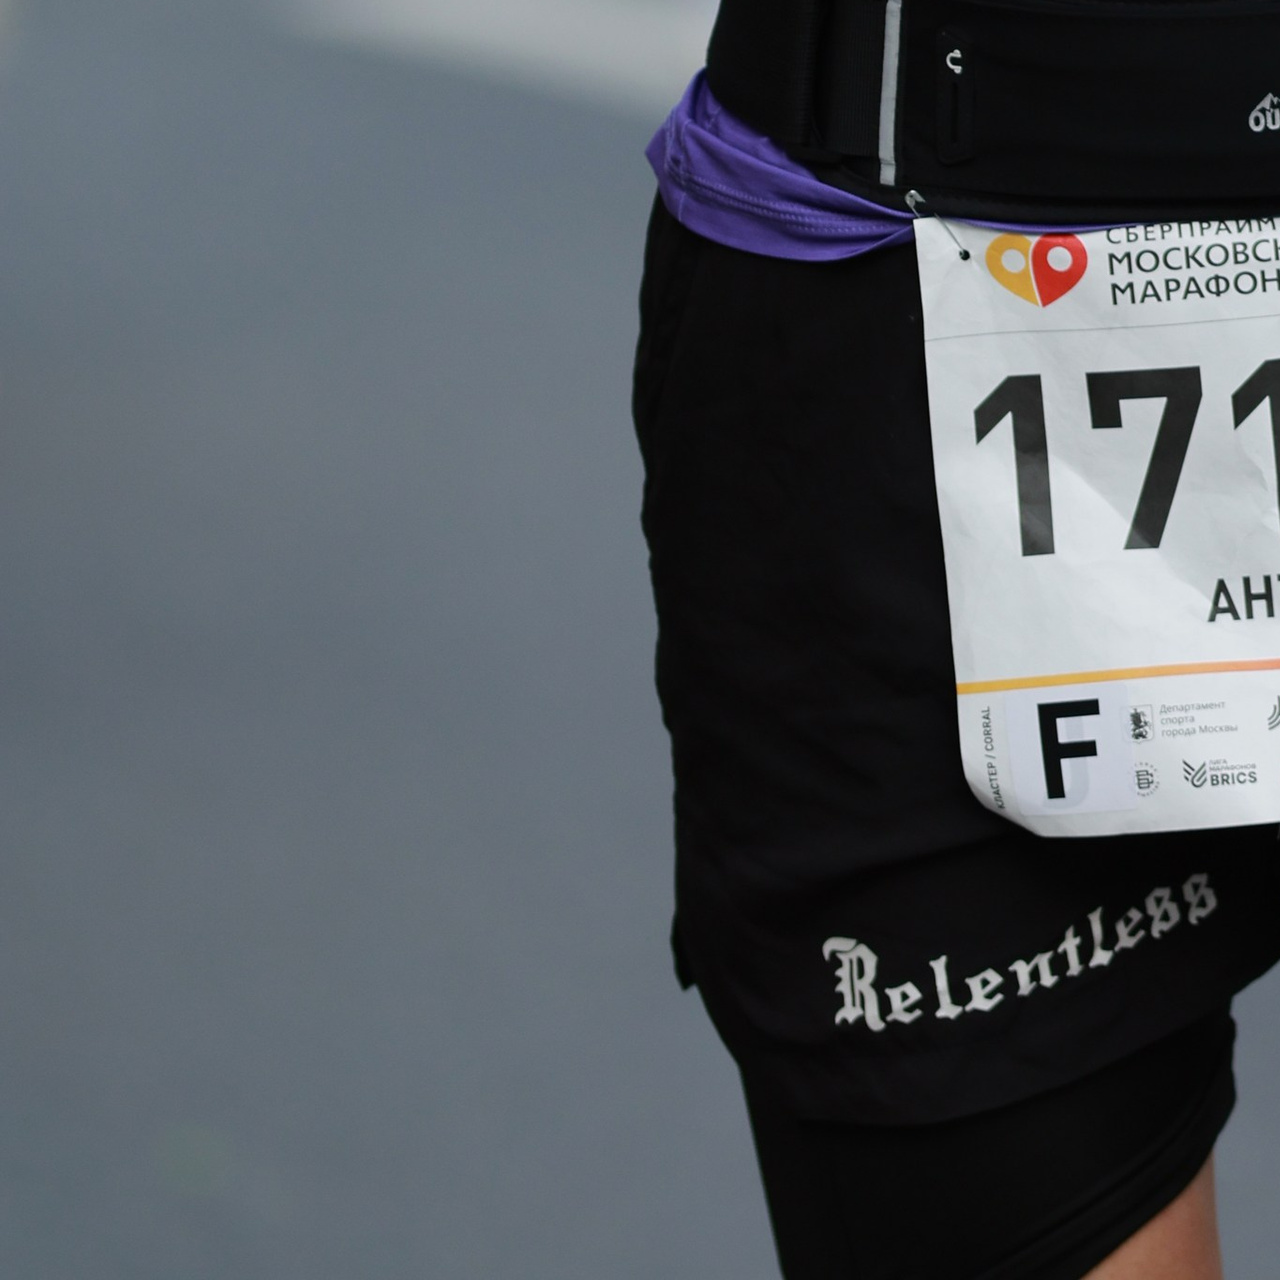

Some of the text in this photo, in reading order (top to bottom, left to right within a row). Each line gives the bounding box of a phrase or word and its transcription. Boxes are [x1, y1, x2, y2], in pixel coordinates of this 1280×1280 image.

[1159, 701, 1226, 715] Департамент
[981, 706, 995, 752] CORRAL
[1160, 715, 1195, 727] спорта
[1161, 724, 1239, 739] города Москвы
[1037, 698, 1100, 800] F
[1209, 771, 1258, 787] BRICS
[822, 872, 1218, 1032] Relentless
